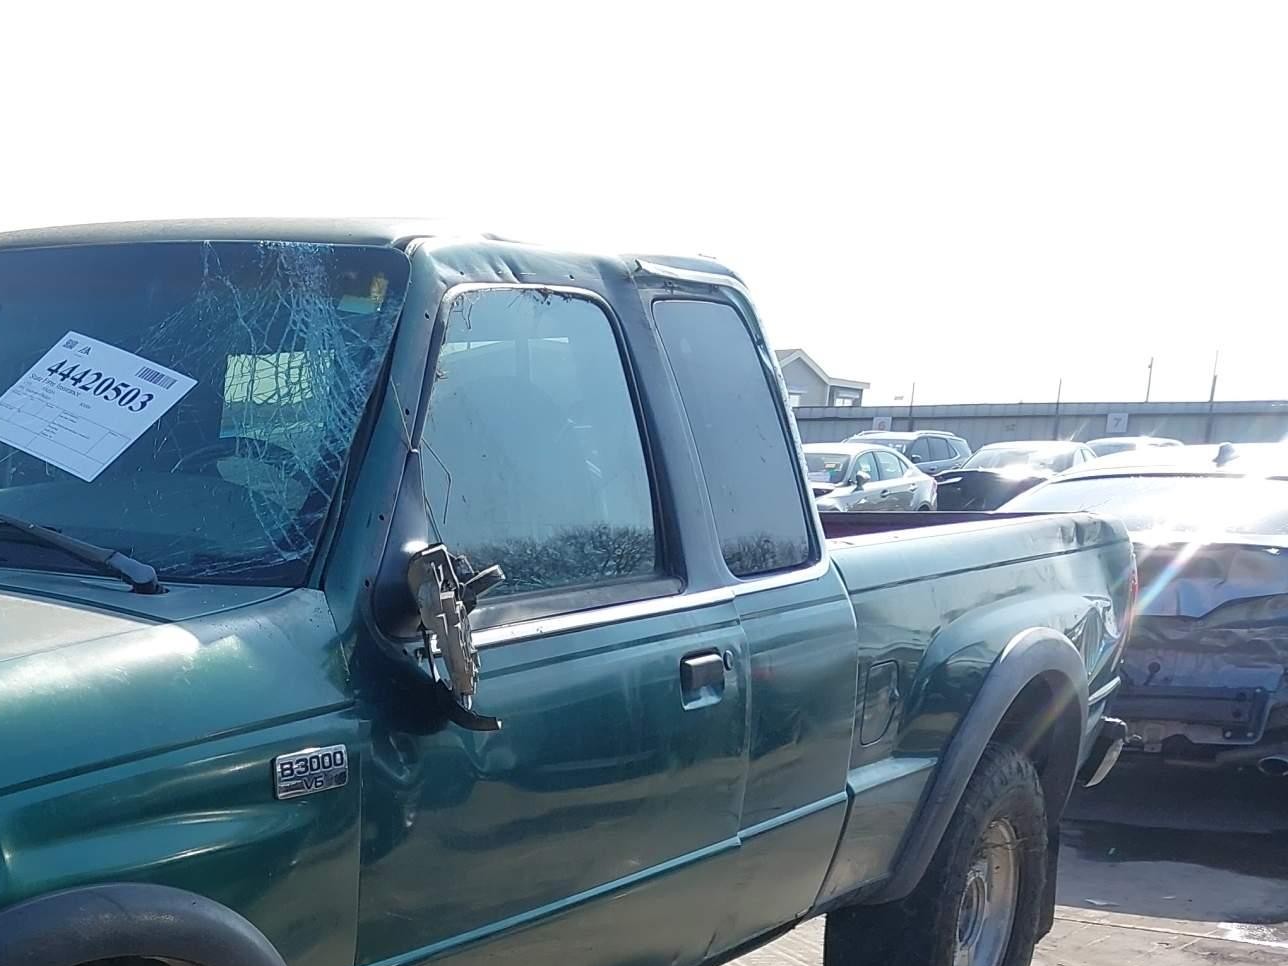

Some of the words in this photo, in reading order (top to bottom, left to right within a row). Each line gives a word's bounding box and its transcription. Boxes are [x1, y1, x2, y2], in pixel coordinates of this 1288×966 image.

[47, 360, 156, 413] 44420503
[280, 751, 344, 778] B3000
[303, 775, 325, 790] V6
